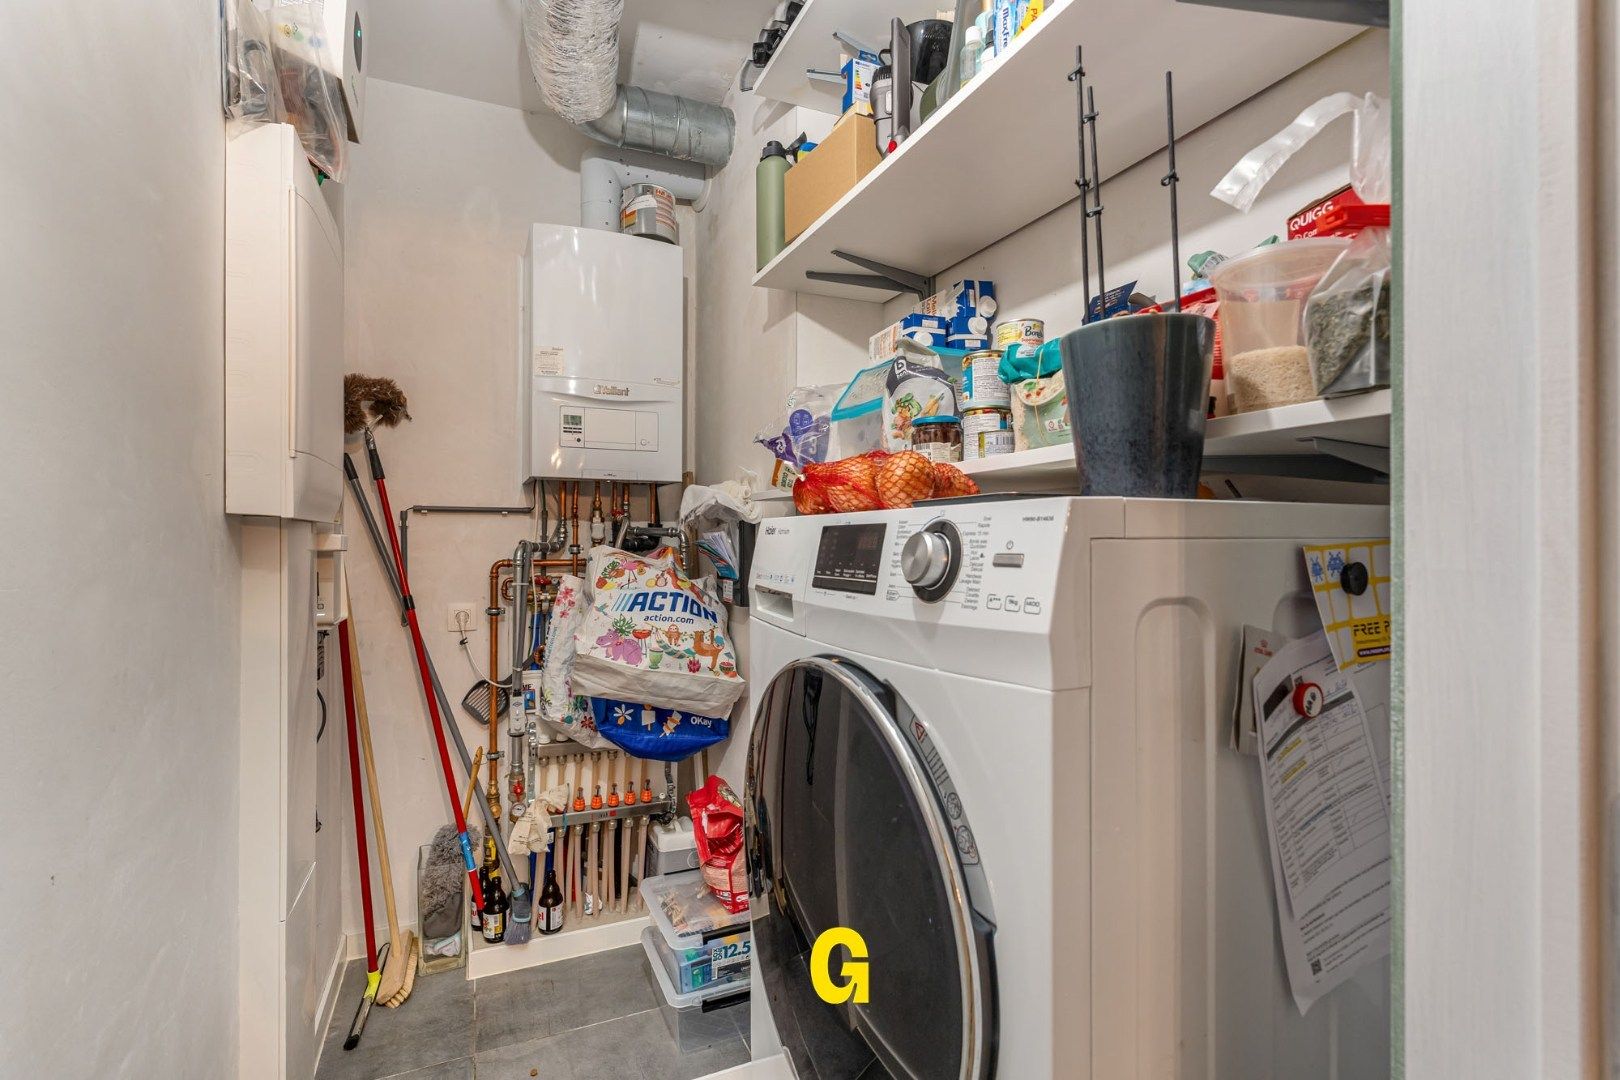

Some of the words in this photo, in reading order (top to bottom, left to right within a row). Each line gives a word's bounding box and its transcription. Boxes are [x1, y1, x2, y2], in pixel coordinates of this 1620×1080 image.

[1290, 200, 1334, 231] QUIGG
[600, 385, 630, 397] Vaillant
[627, 591, 719, 624] ACTION
[643, 613, 695, 625] action.com
[1353, 621, 1381, 637] FREE
[690, 715, 712, 727] OKay
